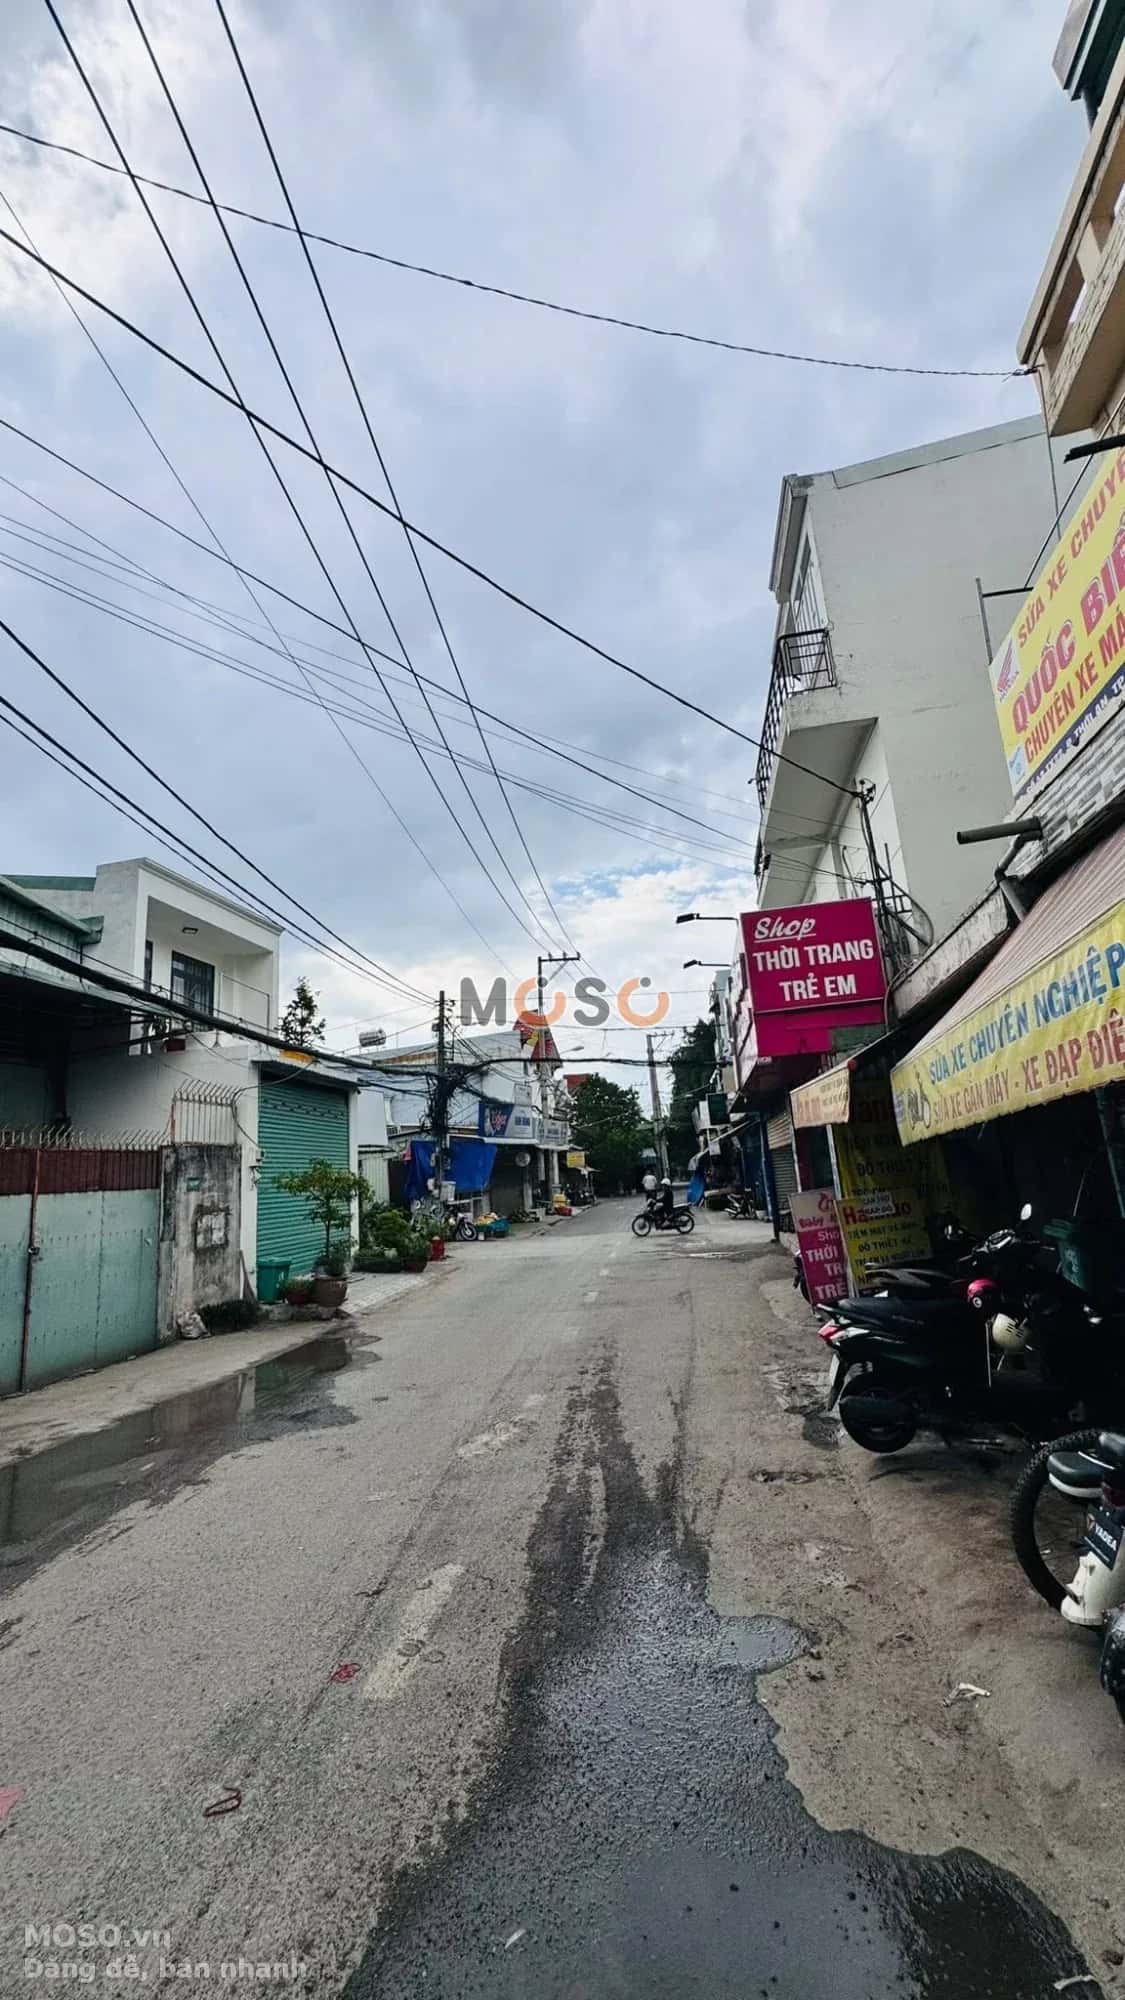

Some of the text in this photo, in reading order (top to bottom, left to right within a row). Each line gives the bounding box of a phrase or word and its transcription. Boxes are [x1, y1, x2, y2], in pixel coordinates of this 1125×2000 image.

[1047, 555, 1068, 600] XE
[1012, 619, 1076, 734] QUỐC
[1024, 682, 1076, 763] CHUYÊN
[1075, 651, 1099, 699] XE
[754, 916, 817, 941] Shop
[752, 938, 875, 973] THỜI TRANG
[778, 972, 857, 1002] TRẺ EM
[949, 1038, 968, 1075] XE
[968, 1003, 1030, 1064] CHUYÊN
[1032, 942, 1125, 1027] NGHIỆP
[950, 1091, 962, 1119] XE
[1021, 1055, 1044, 1094] XE
[1044, 1037, 1083, 1089] ĐẠP
[817, 1230, 841, 1242] Sho
[1095, 1522, 1117, 1551] YADEA
